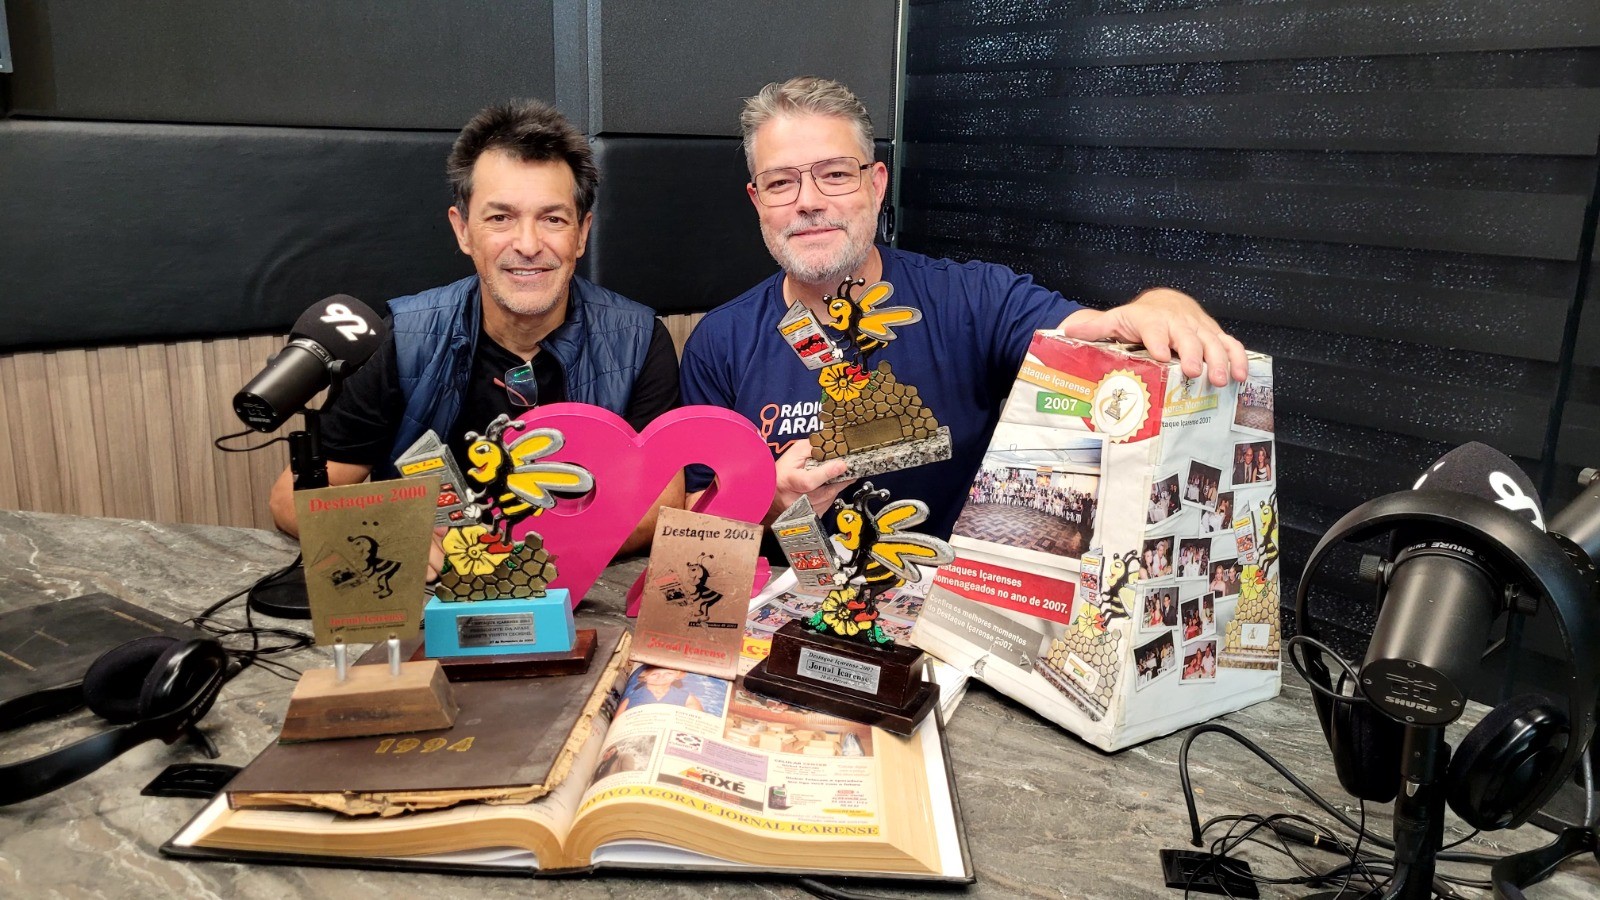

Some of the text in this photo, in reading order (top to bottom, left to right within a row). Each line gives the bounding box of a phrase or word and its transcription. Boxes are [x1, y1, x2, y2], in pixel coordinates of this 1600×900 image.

[320, 303, 369, 341] 92
[1020, 365, 1091, 395] staque Içarense
[1044, 397, 1078, 411] 2007
[778, 416, 824, 435] ARA
[1199, 416, 1211, 425] 2007
[309, 485, 427, 513] Destaque 2000
[662, 526, 755, 541] Destaque 2001
[979, 569, 1022, 588] Içarenses
[997, 589, 1009, 599] no
[1010, 592, 1028, 603] ano
[1029, 595, 1042, 606] de
[1043, 599, 1068, 614] 2007.
[927, 604, 936, 613] do
[937, 608, 966, 627] Destaque
[966, 622, 994, 642] Içarense
[929, 593, 1027, 646] Confira os melhores momentos
[808, 652, 833, 663] Destaque
[808, 661, 835, 674] Jornal
[1384, 696, 1438, 713] SHURE
[375, 736, 476, 753] 1994
[701, 773, 746, 795] AXÉ
[716, 809, 785, 831] JORNAL
[790, 823, 879, 835] IÇARENSE
